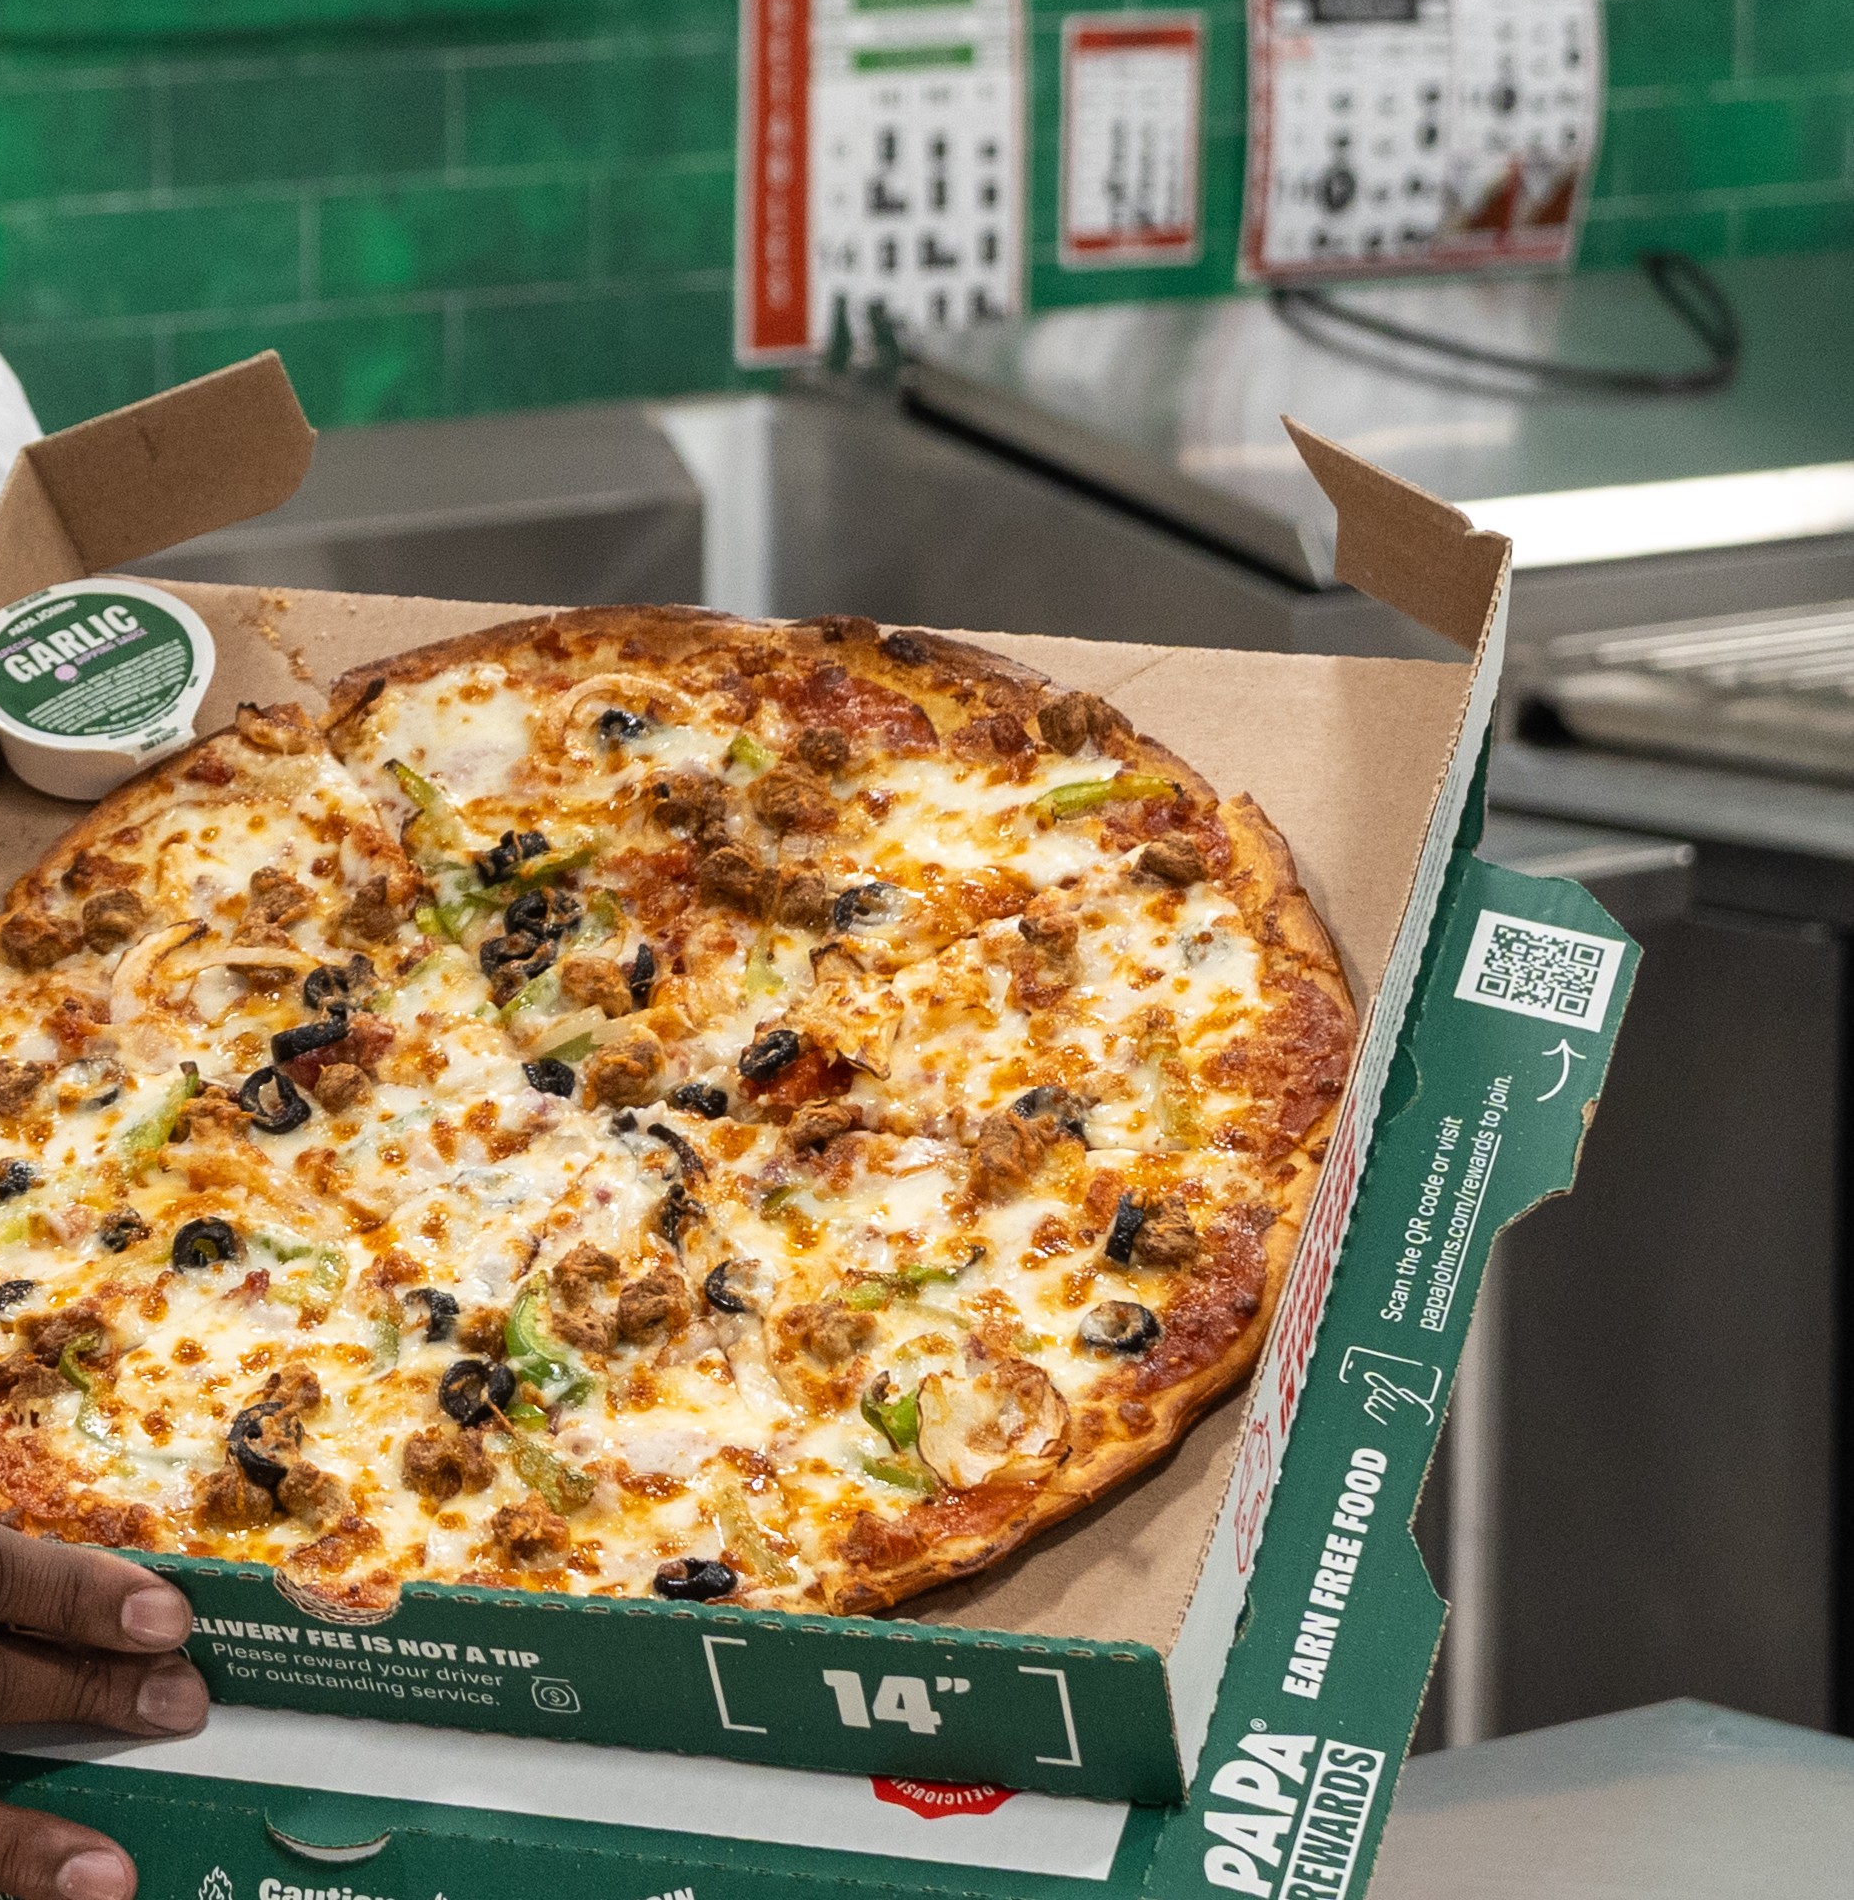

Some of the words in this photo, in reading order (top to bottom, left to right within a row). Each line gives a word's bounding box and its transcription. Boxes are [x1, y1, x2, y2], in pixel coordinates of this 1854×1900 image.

[2, 604, 139, 684] GARLIC
[1483, 1074, 1513, 1112] join.
[1435, 1115, 1464, 1152] visit
[1478, 1107, 1500, 1129] to
[1432, 1152, 1451, 1174] or
[1418, 1173, 1445, 1218] code
[1404, 1217, 1432, 1245] QR
[1419, 1129, 1497, 1331] papajohns.com/rewards
[1396, 1245, 1423, 1276] the
[1280, 1372, 1296, 1437] IN
[1296, 1243, 1331, 1372] YOUR
[1333, 1149, 1357, 1249] CAR
[1380, 1277, 1413, 1323] Scan
[1332, 1448, 1388, 1534] FOOD
[1309, 1533, 1364, 1611] FREE
[191, 1616, 300, 1647] ELIVERY
[308, 1629, 355, 1652] FEE
[360, 1634, 391, 1654] IS
[397, 1638, 460, 1663] NOT
[463, 1645, 489, 1665] A
[491, 1647, 541, 1670] TIP
[212, 1641, 288, 1664] Please
[293, 1651, 372, 1673] reward
[377, 1660, 431, 1682] your
[436, 1666, 504, 1688] driver
[1282, 1610, 1341, 1700] EARN
[226, 1661, 261, 1679] for
[265, 1666, 406, 1699] outstanding
[410, 1682, 501, 1707] service.
[1285, 1748, 1377, 1900] REWARDS
